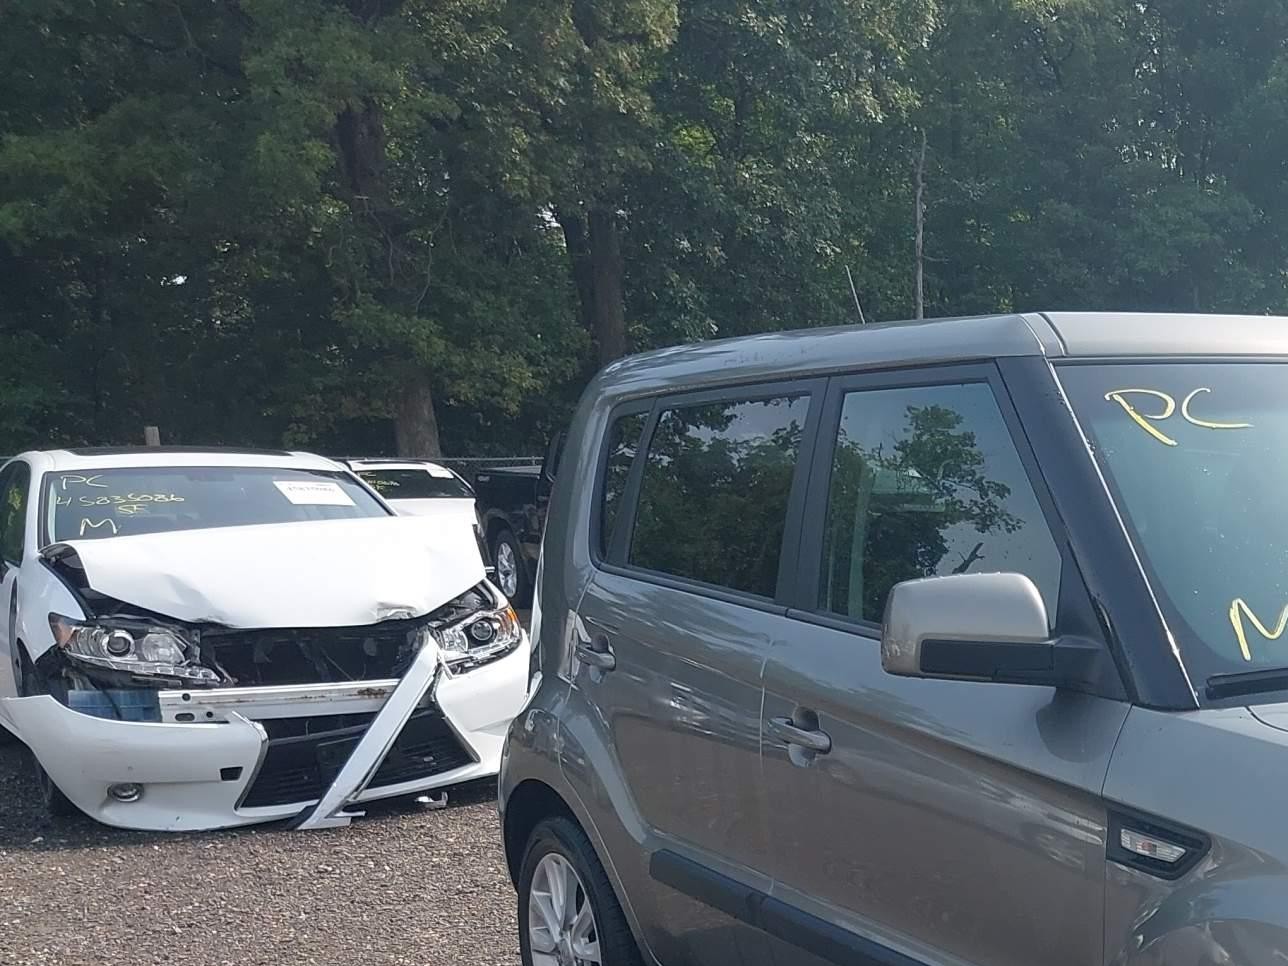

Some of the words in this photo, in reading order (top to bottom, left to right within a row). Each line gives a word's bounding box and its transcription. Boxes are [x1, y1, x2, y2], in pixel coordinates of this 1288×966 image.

[1104, 387, 1254, 447] PC
[60, 474, 109, 490] PC
[79, 518, 119, 536] M
